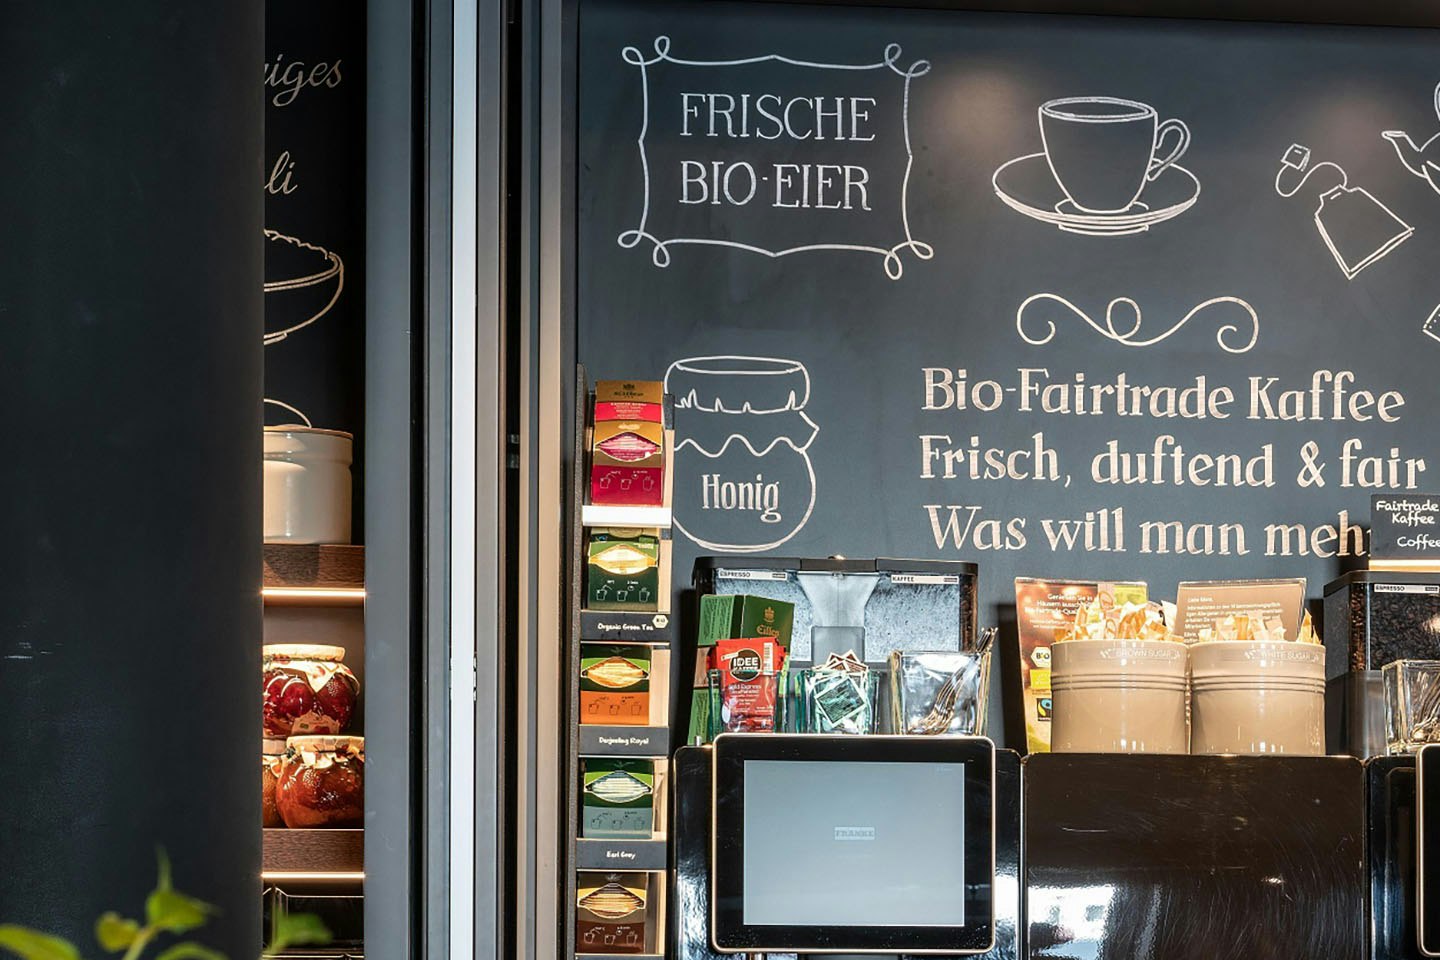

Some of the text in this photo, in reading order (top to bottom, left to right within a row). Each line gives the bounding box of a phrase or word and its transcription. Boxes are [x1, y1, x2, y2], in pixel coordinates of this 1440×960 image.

[679, 92, 877, 142] FRISCHE
[264, 150, 298, 194] li
[921, 367, 1406, 423] Bio-Fairtrade Kaffee
[919, 431, 1428, 490] Frisch, duftend & fair
[702, 473, 782, 523] Honig
[1376, 499, 1440, 512] Fairtrade
[1391, 510, 1436, 527] Kaffee
[923, 503, 1371, 559] Was will man meh
[720, 571, 751, 579] ESPRESSO
[891, 575, 915, 583] KAFFEE
[597, 623, 654, 632] Organic Green Tea
[733, 657, 759, 667] IDEE
[630, 737, 649, 746] Royal
[606, 850, 620, 858] Earl
